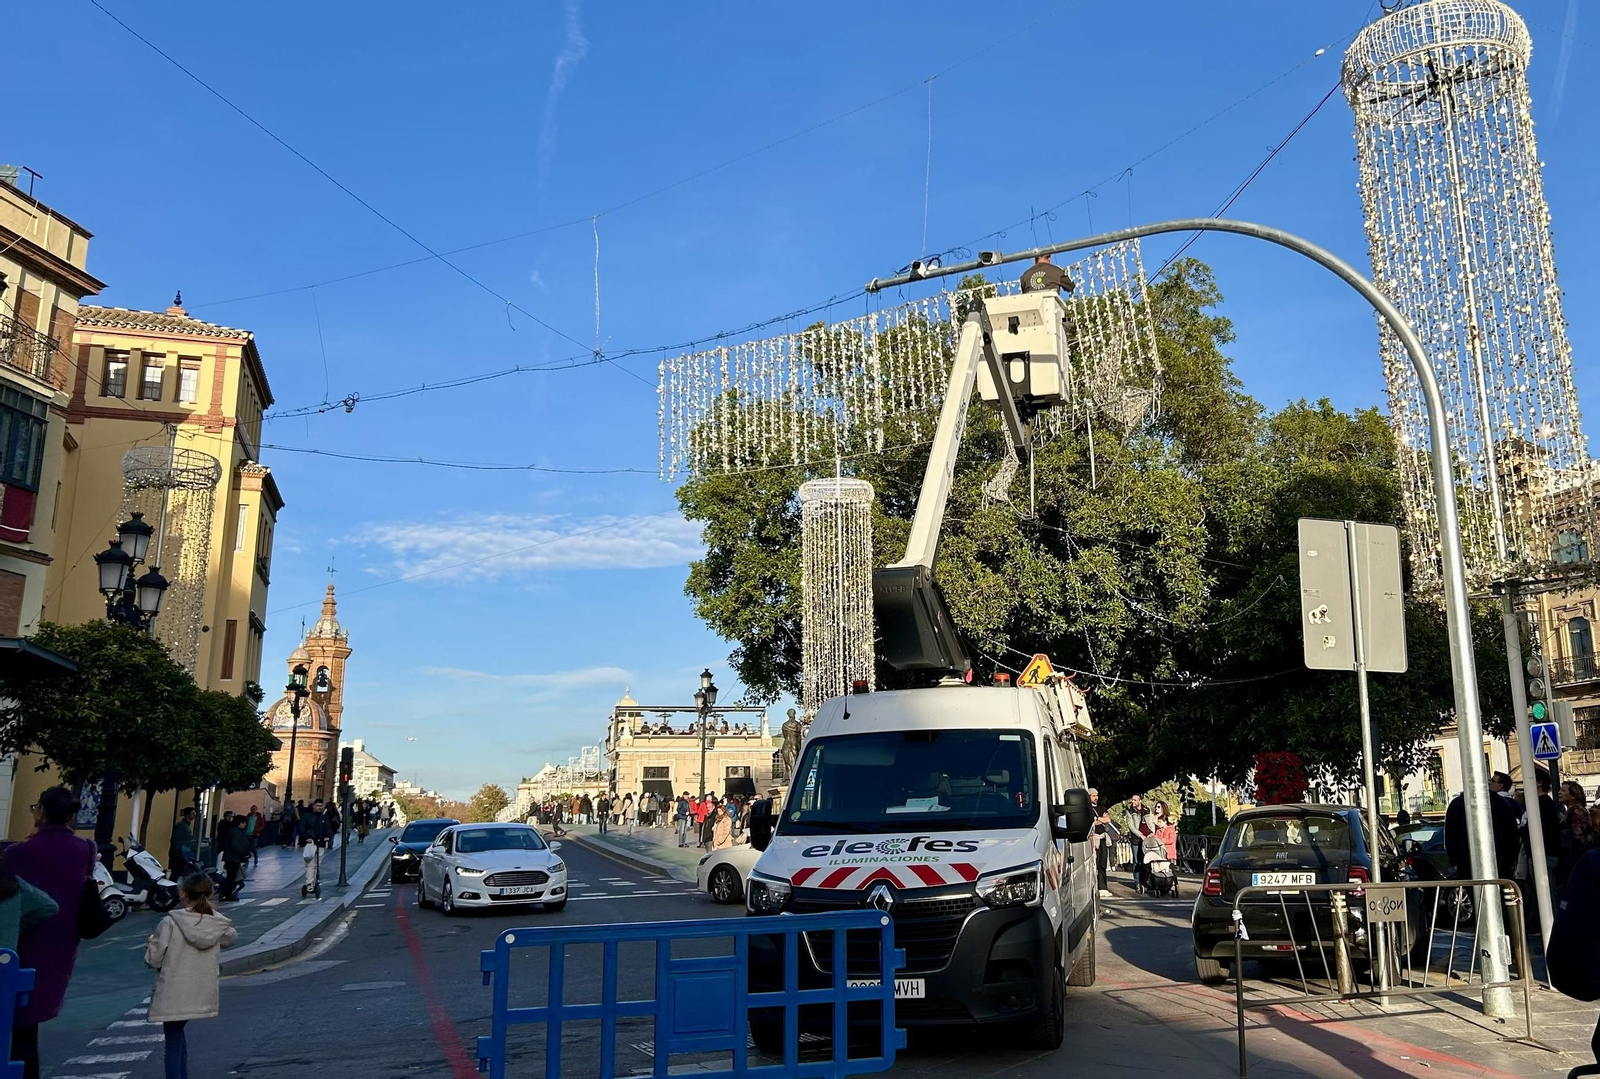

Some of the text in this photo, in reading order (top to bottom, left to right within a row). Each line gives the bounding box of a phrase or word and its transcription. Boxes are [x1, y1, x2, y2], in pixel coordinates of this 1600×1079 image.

[828, 855, 940, 866] ILUMINACIONES
[1275, 851, 1289, 859] FIAT
[1260, 874, 1313, 885] 9247 MFB
